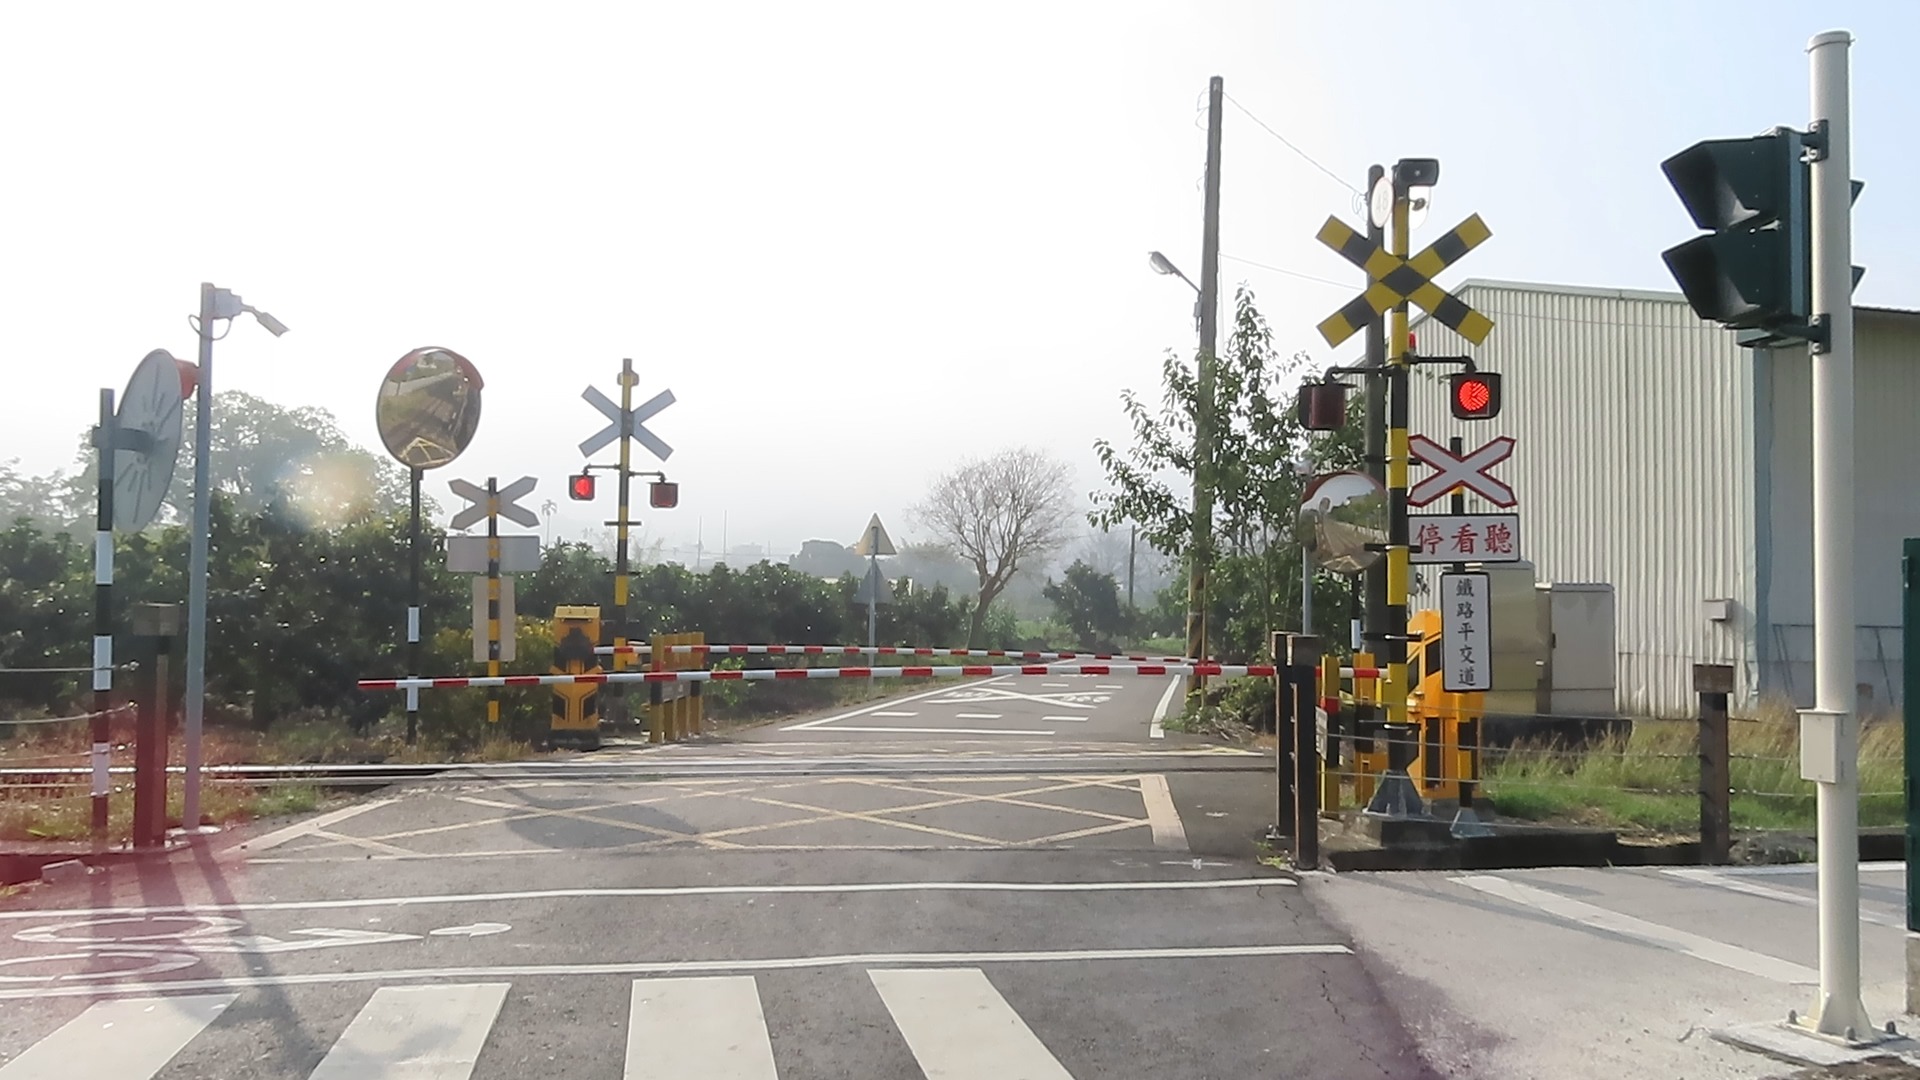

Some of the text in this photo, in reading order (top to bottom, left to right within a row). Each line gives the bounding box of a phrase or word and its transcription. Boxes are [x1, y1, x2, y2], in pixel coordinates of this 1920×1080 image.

[1416, 523, 1513, 555] 停看聽
[1456, 578, 1476, 687] 鐵路平交道
